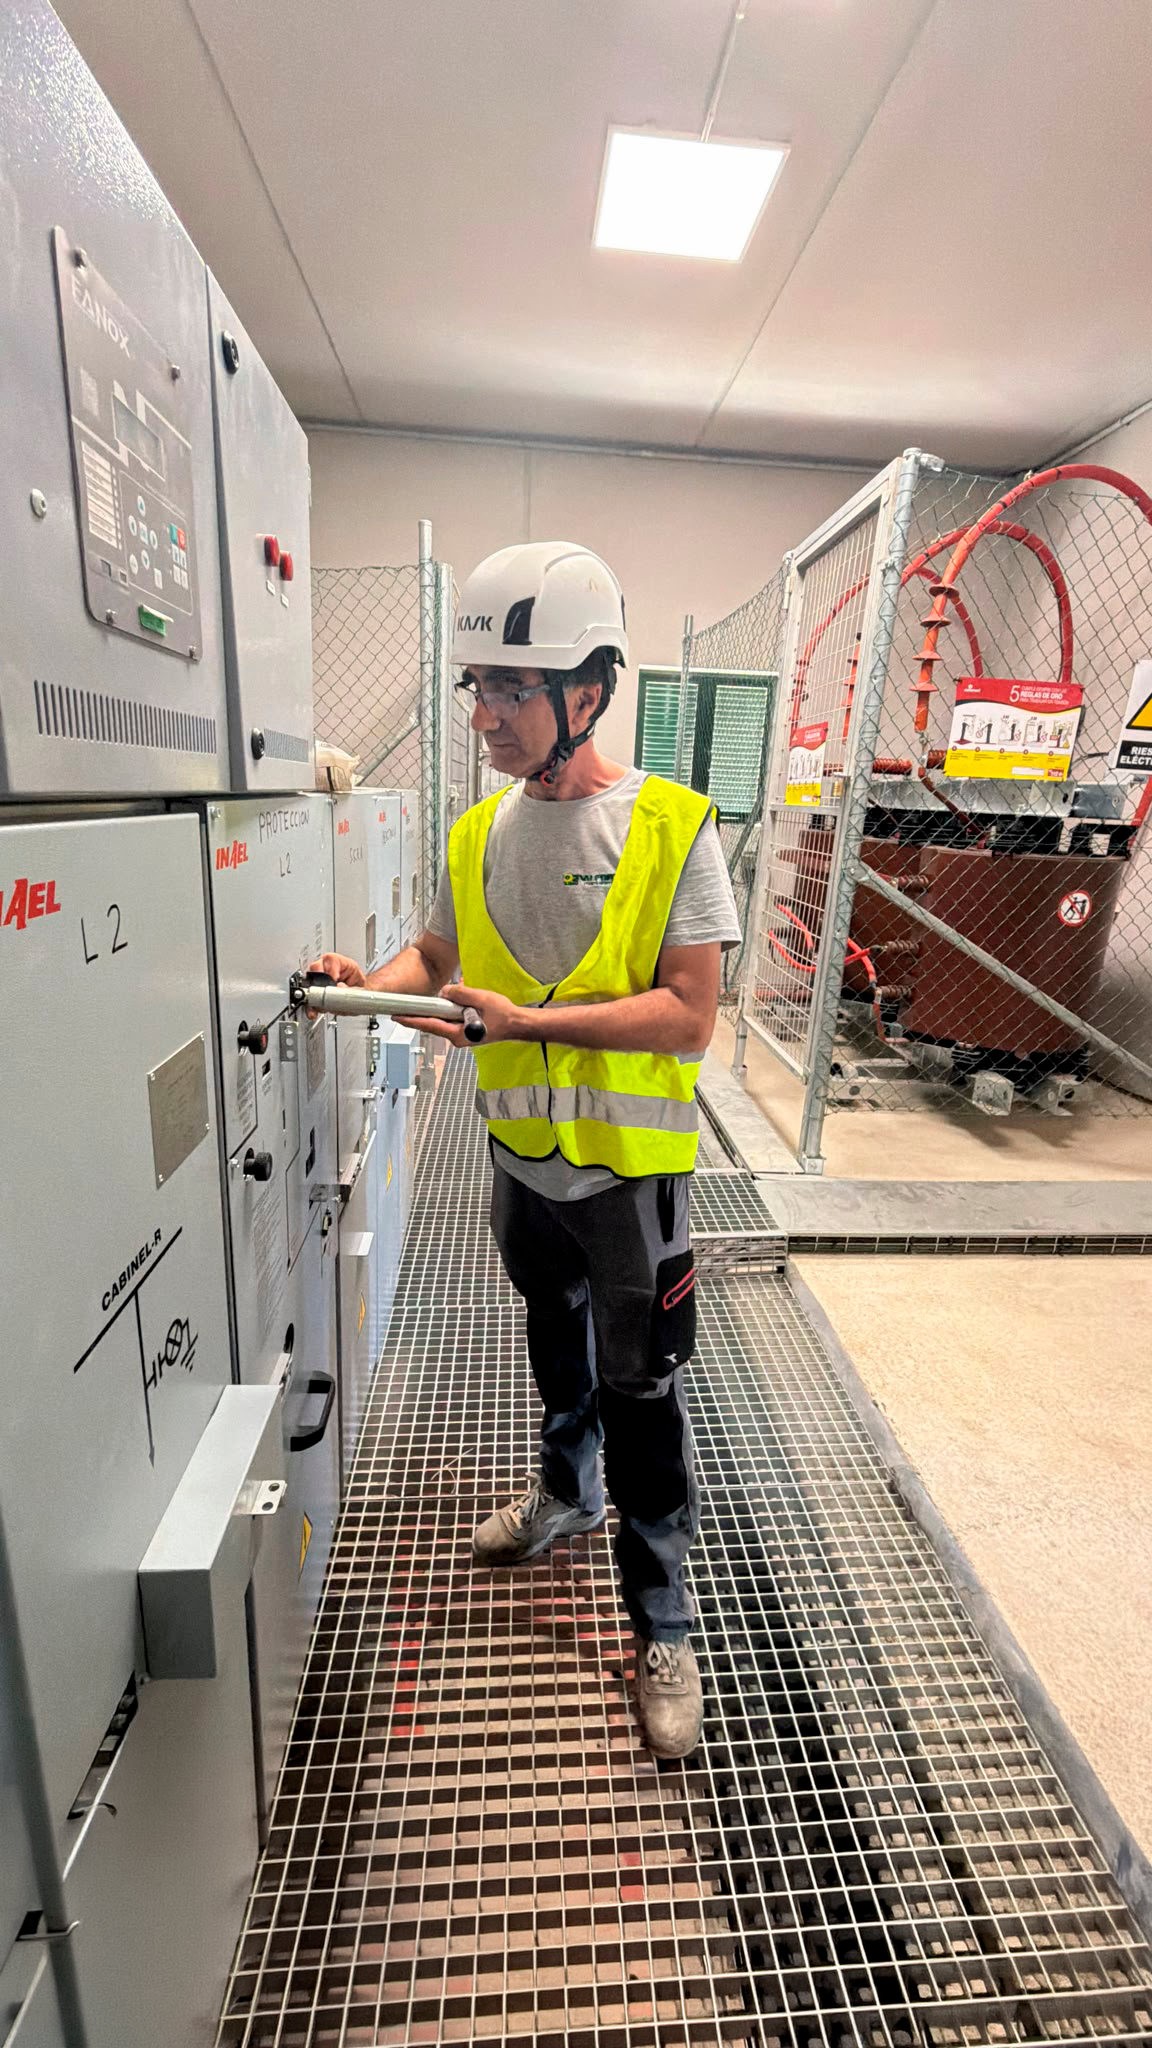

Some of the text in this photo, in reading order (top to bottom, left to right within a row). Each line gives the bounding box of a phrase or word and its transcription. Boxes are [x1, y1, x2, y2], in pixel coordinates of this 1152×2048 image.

[457, 615, 493, 631] KASK
[1009, 684, 1021, 703] 5
[1020, 690, 1042, 699] REGLAS
[1050, 692, 1063, 701] ORO
[1120, 755, 1152, 766] ELÉCT
[258, 808, 310, 843] PROTECCION
[215, 839, 249, 870] INAEL
[0, 878, 62, 930] AEL
[101, 1227, 163, 1312] CABINEL-R
